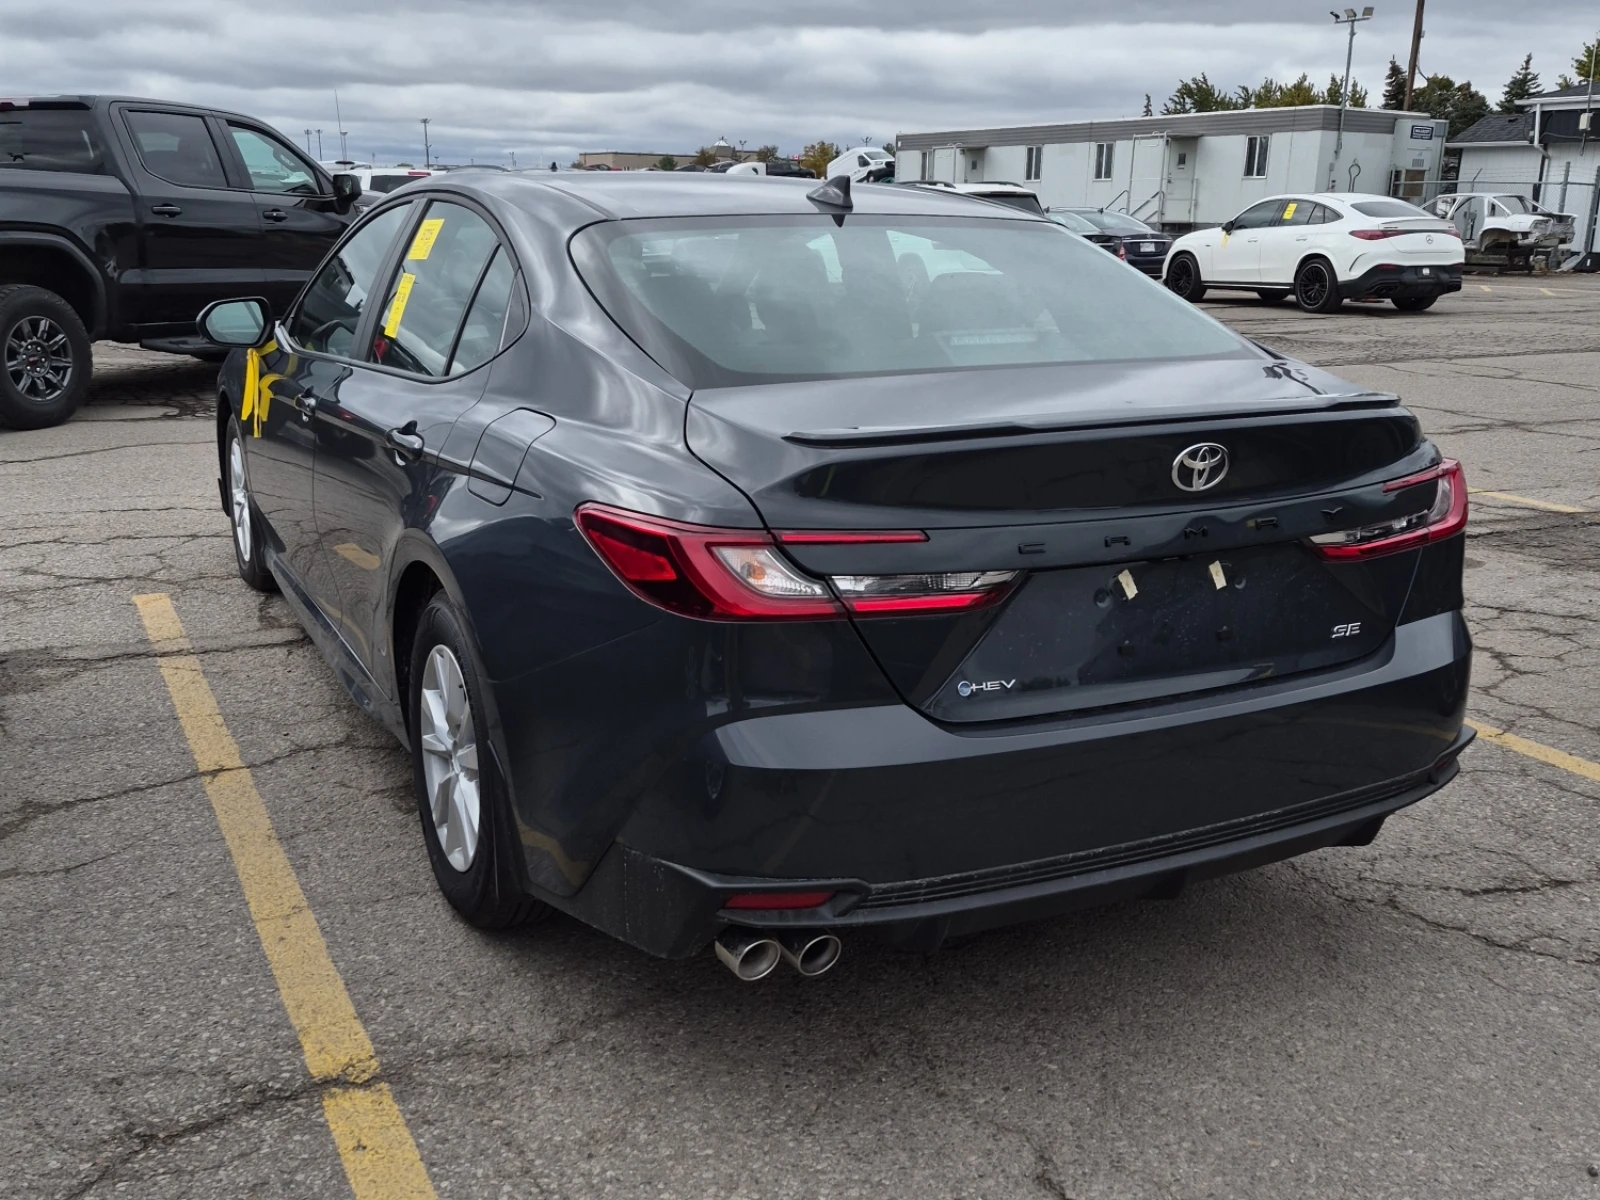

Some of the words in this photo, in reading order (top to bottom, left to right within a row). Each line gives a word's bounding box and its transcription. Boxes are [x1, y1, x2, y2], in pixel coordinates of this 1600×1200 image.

[1018, 506, 1343, 554] CAMRY
[1331, 622, 1361, 638] SE
[971, 679, 1016, 692] HEV
